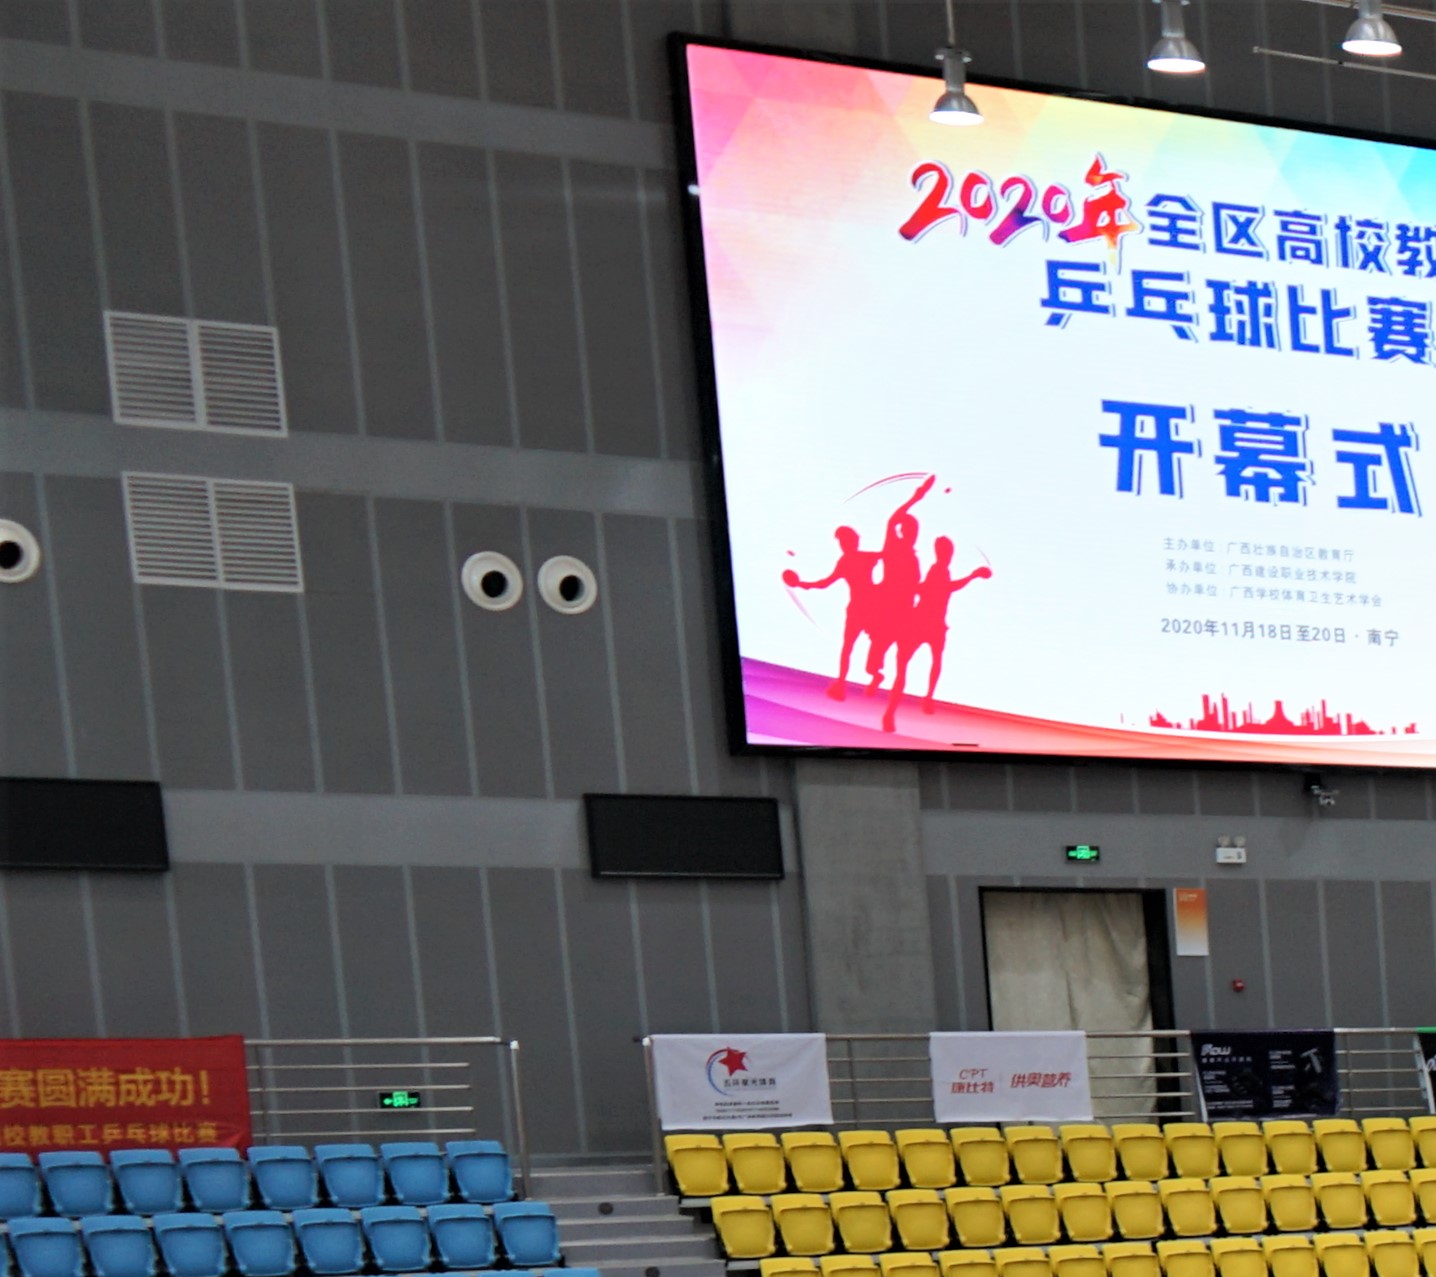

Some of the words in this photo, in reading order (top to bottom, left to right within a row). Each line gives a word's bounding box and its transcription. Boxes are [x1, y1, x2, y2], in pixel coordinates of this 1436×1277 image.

[1040, 259, 1436, 366] 乒乓球比赛
[1098, 399, 1423, 517] 开幕式
